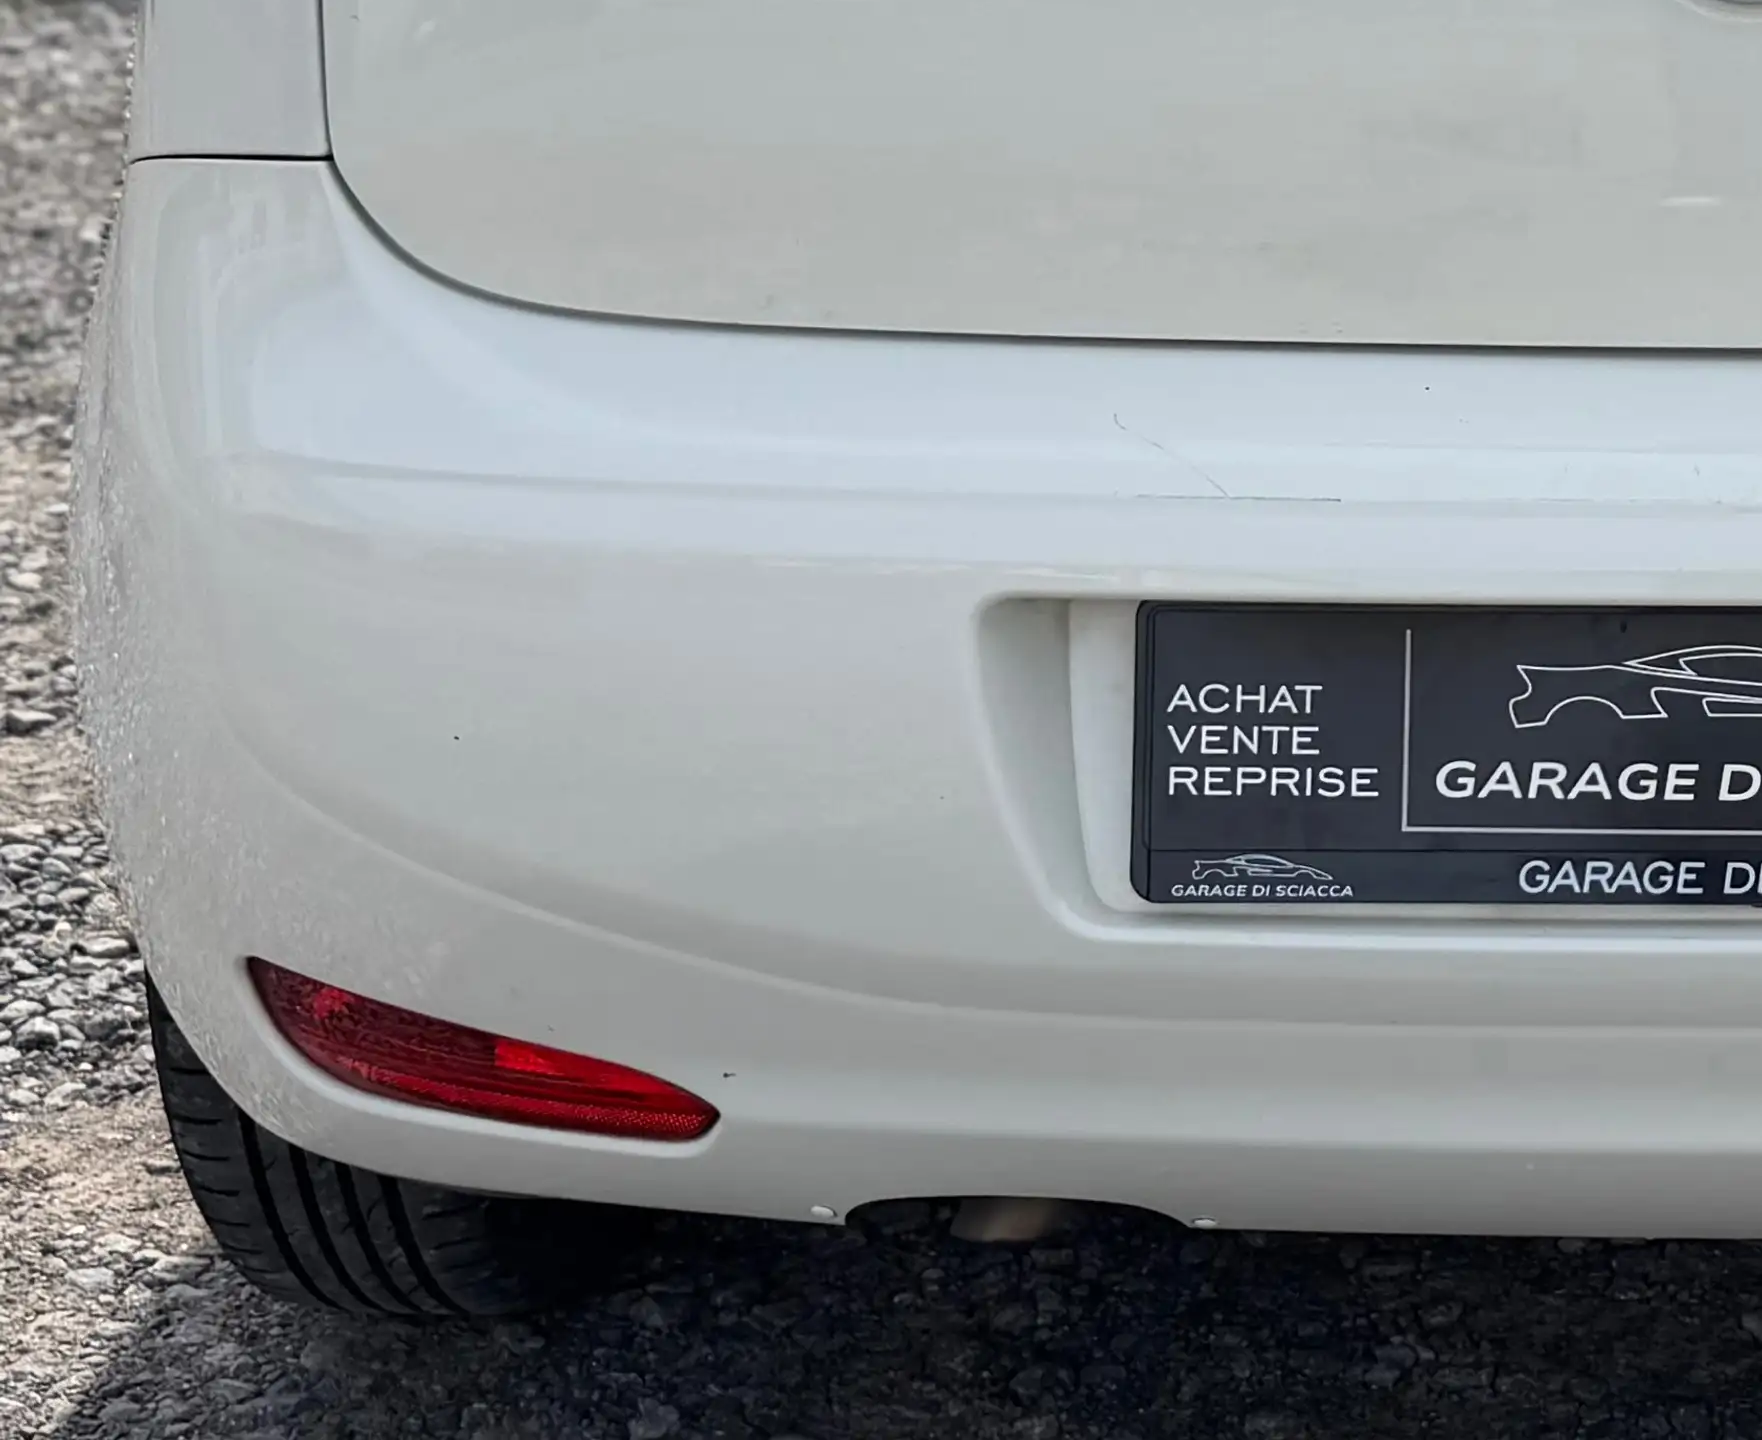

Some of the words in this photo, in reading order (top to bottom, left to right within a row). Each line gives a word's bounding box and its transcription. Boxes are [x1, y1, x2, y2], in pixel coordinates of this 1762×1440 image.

[1166, 683, 1323, 714] ACHAT
[1167, 724, 1320, 755] VENTE
[1168, 766, 1380, 798] REPRISE
[1435, 760, 1700, 801] GARAGE
[1171, 884, 1249, 898] GARAGE
[1252, 885, 1271, 897] DI
[1275, 885, 1354, 898] SCIACCA
[1518, 860, 1706, 894] GARAGE
